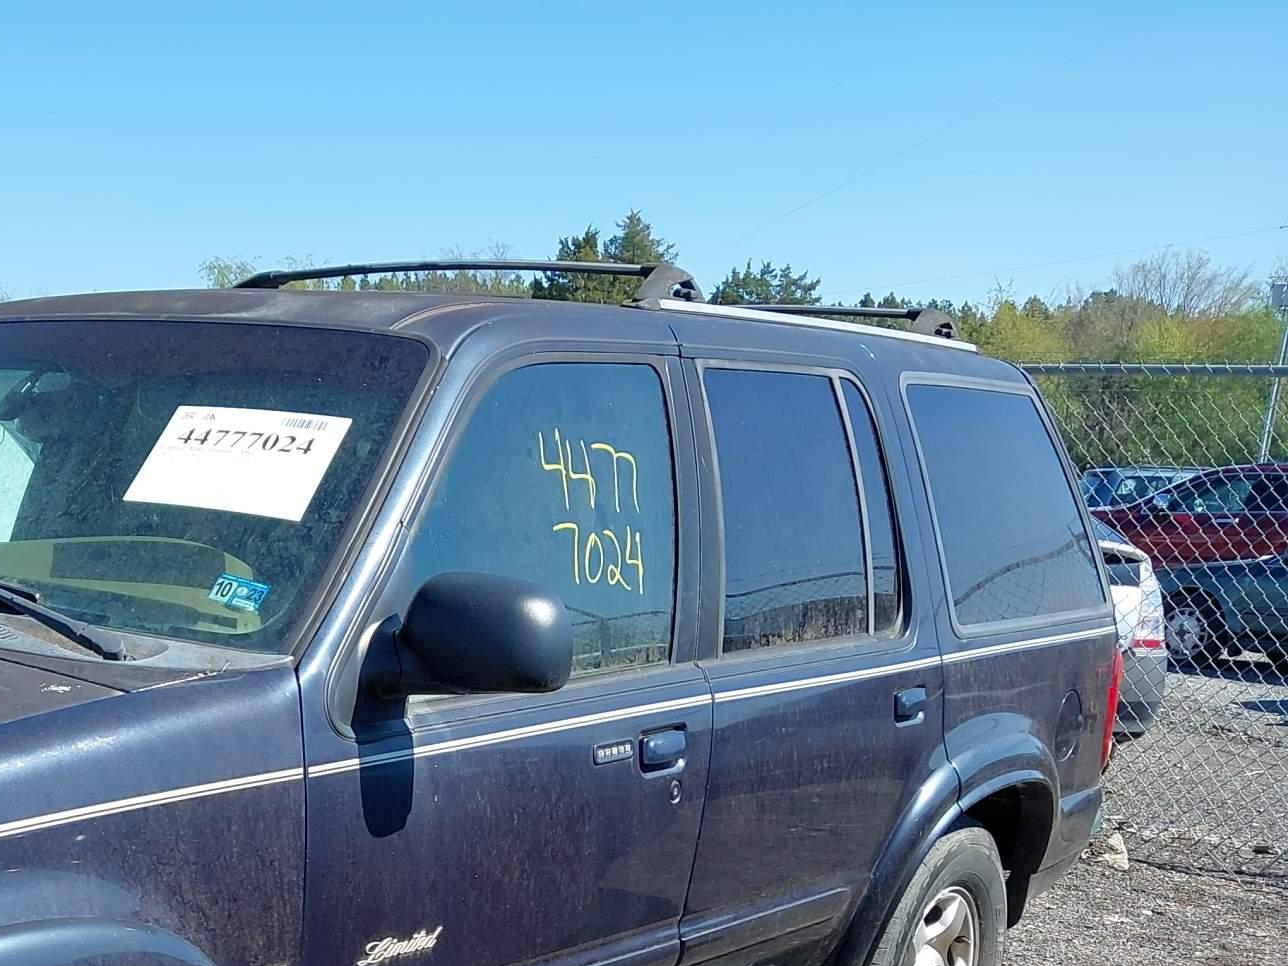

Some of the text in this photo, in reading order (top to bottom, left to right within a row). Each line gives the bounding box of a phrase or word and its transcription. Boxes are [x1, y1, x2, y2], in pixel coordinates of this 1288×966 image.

[176, 427, 316, 455] 44777024
[538, 426, 641, 514] 4477
[552, 521, 645, 596] 7024
[215, 579, 233, 598] 10
